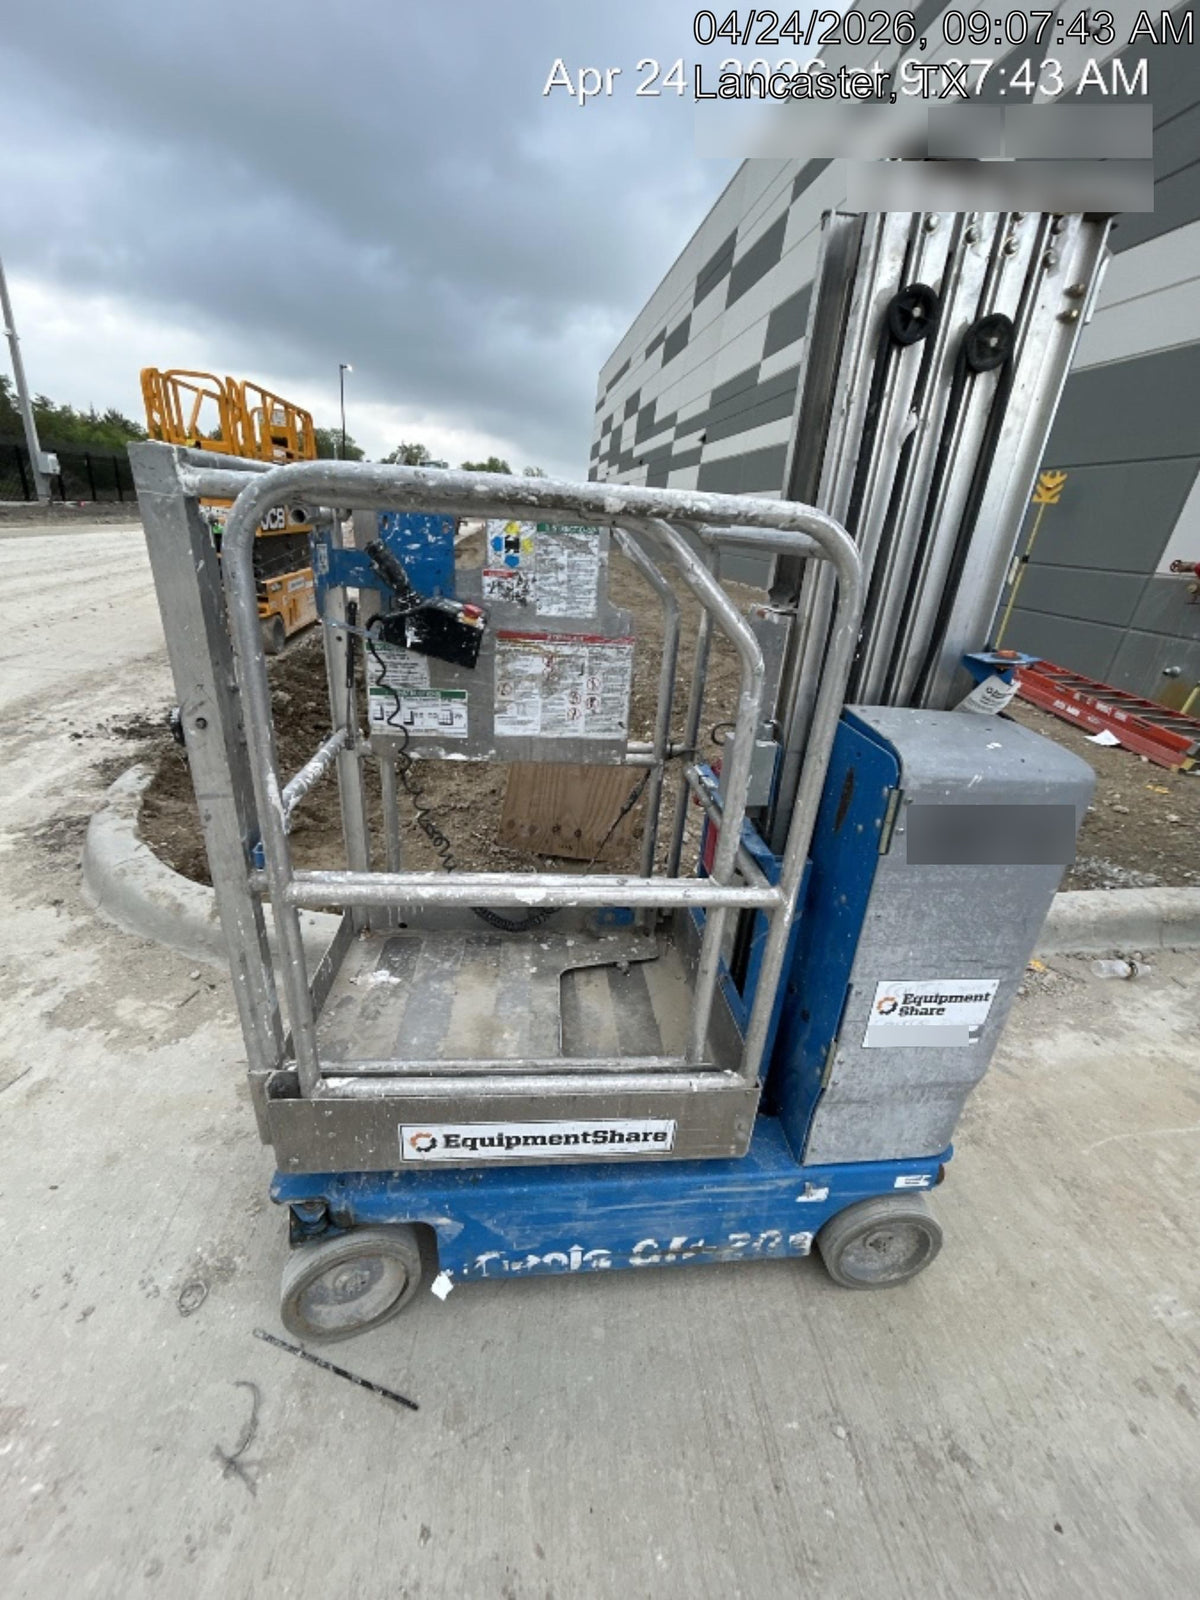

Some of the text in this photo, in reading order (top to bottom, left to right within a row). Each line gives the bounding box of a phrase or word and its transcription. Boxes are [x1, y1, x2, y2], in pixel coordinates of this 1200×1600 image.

[901, 992, 991, 1007] Equipment
[898, 1006, 946, 1017] Share
[442, 1129, 668, 1150] EquipmentShare
